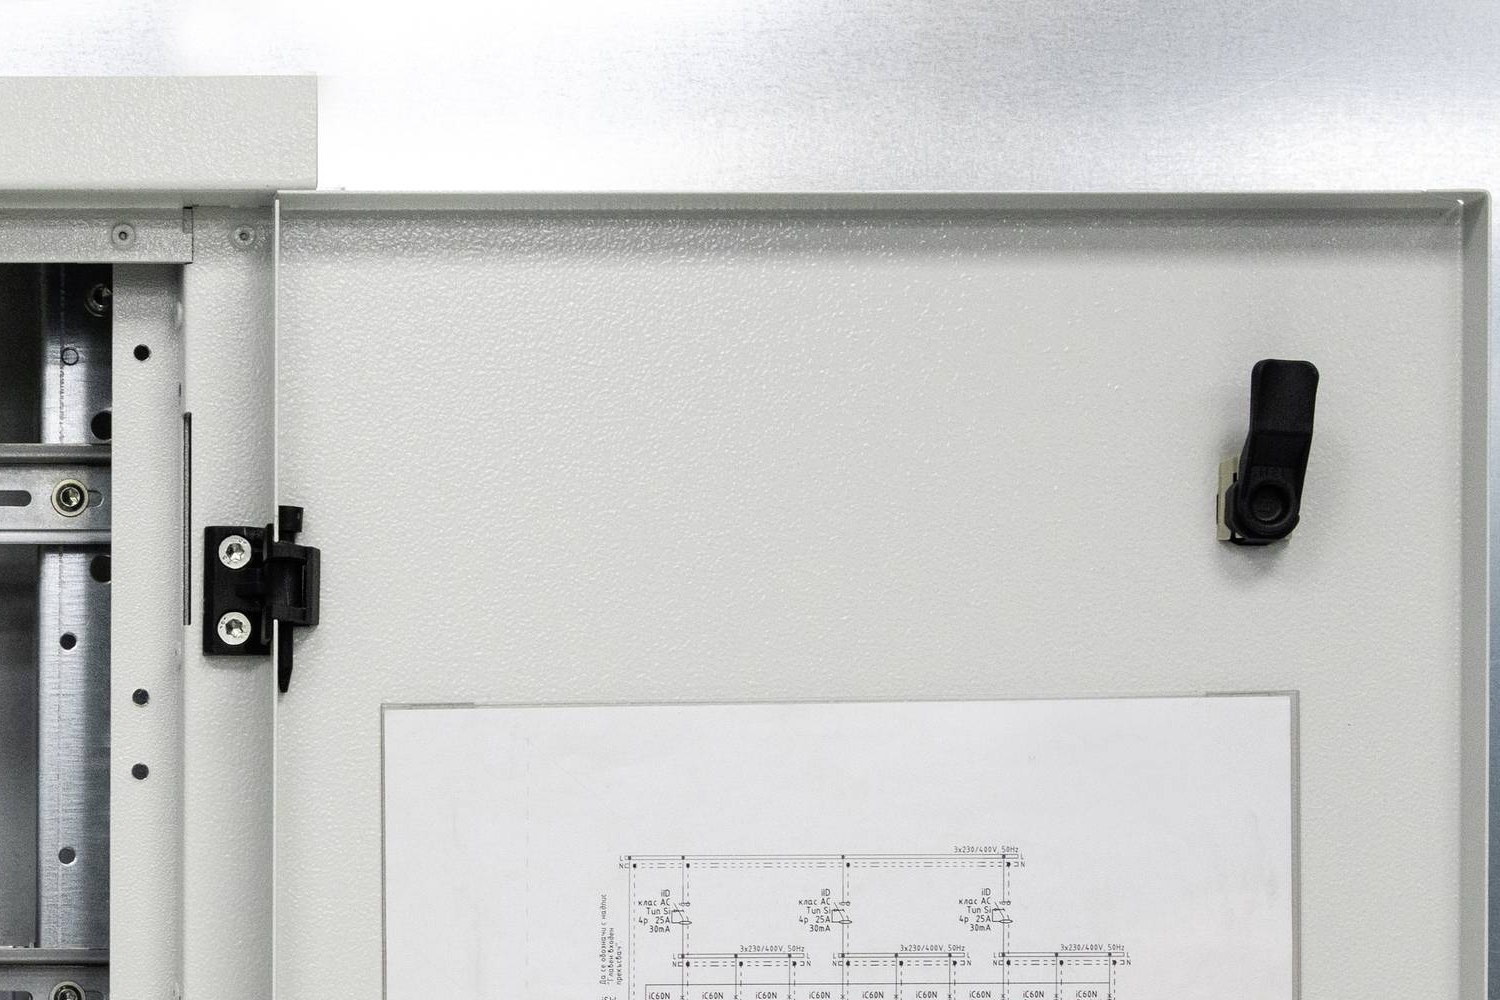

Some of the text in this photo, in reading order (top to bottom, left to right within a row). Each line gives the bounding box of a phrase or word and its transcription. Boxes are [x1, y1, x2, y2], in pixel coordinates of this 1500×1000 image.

[1000, 846, 1018, 854] 50Hz
[656, 916, 670, 924] 25A
[816, 915, 830, 925] 25A
[650, 925, 670, 933] 30mA
[810, 924, 830, 932] 30mA
[786, 945, 804, 953] 50Hz
[946, 944, 965, 952] 50Hz
[1106, 944, 1124, 952] 50Hz
[649, 992, 670, 1000] iC60N
[756, 992, 777, 1000] iC60N
[809, 991, 830, 1000] iC60N
[863, 991, 884, 1000] iC60N
[1023, 991, 1044, 1000] iC60N
[1076, 990, 1097, 1000] iC60N
